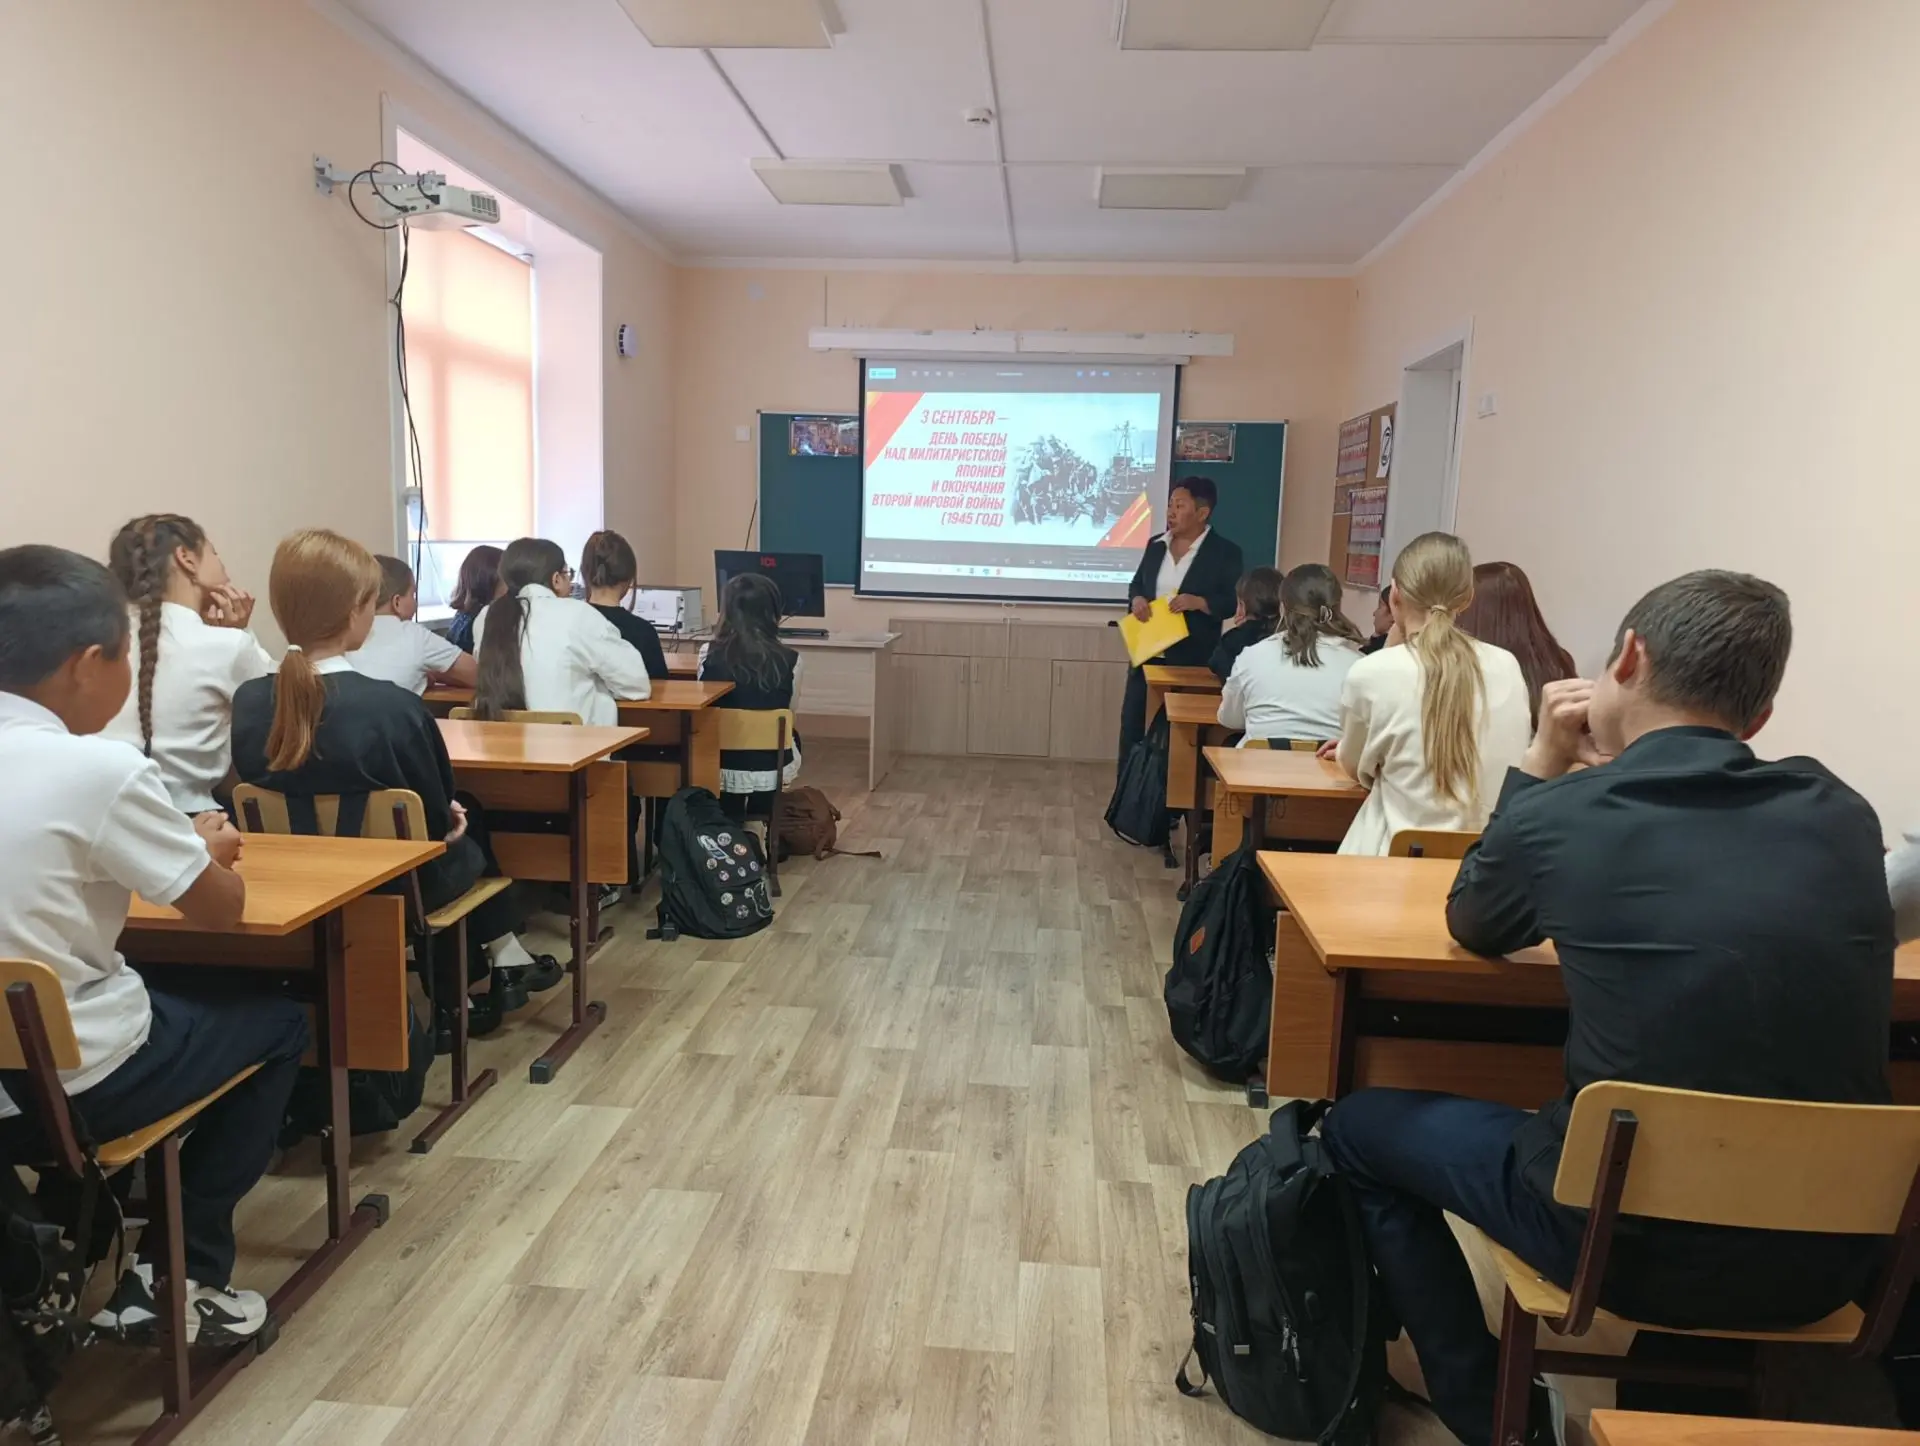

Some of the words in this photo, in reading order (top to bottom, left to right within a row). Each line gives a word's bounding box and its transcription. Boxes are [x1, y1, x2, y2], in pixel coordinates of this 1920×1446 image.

[921, 410, 930, 424] 3
[931, 410, 996, 425] СЕНТЯБРЯ
[929, 431, 958, 446] ДЕНЬ
[960, 432, 1008, 447] ПОБЕДЫ
[884, 447, 906, 460] НАД
[908, 447, 1007, 462] МИЛИТАРИСТСКОЙ
[955, 463, 1006, 478] ЯПОНИЕЙ
[931, 480, 939, 492] И
[941, 480, 1006, 494] ОКОНЧАНИЯ
[872, 492, 912, 506] ВТОРОЙ
[914, 494, 964, 509] МИРОВОЙ
[965, 495, 1006, 510] ВОЙНЫ
[941, 511, 974, 525] (1945
[975, 513, 1004, 527] ГОД)
